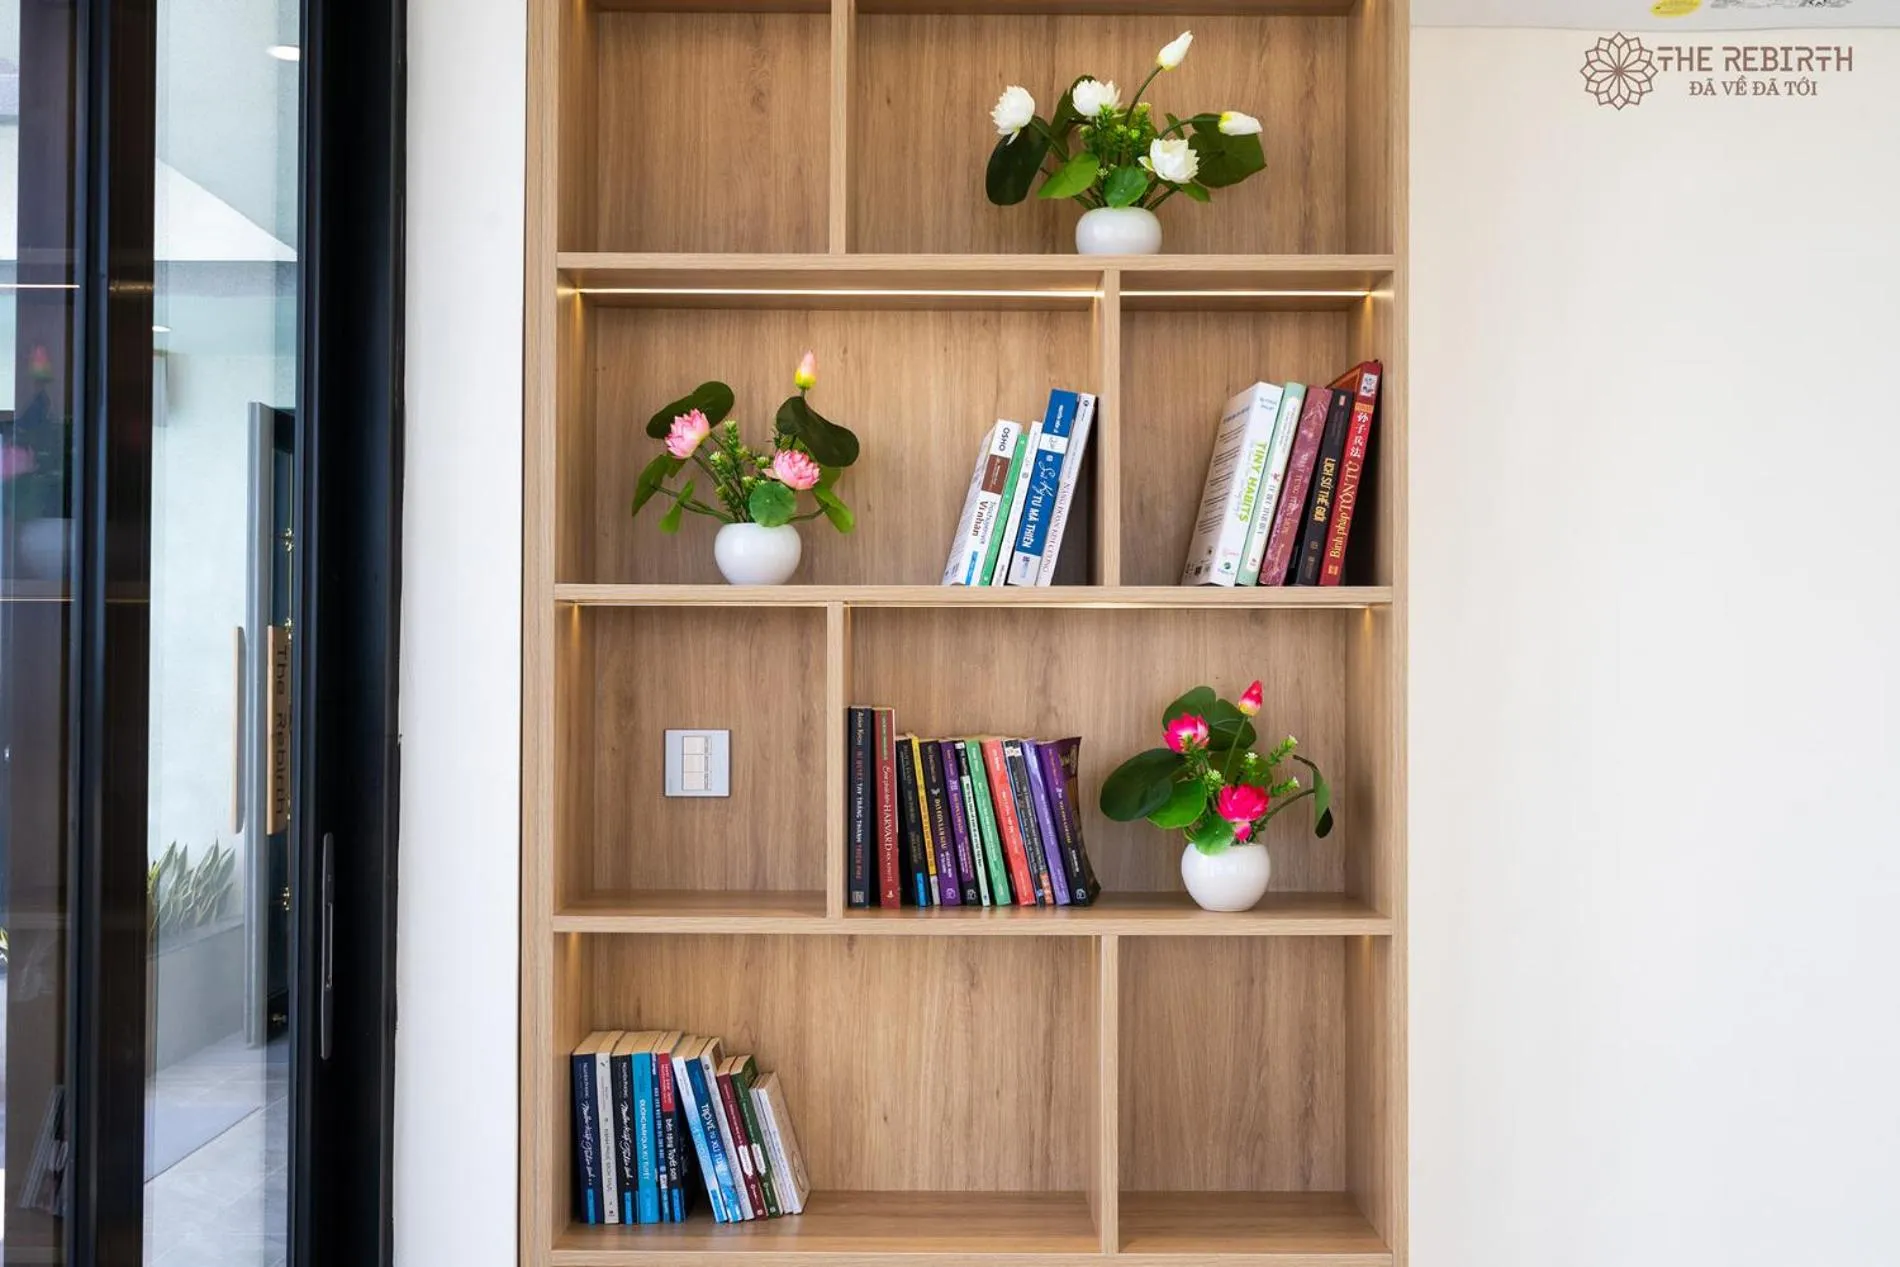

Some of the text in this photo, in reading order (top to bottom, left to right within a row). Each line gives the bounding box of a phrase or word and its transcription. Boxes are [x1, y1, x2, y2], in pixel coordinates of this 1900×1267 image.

[997, 427, 1010, 451] OSHO
[1252, 442, 1267, 472] TINY
[1239, 477, 1258, 522] HABITS
[883, 804, 893, 850] HARVARD
